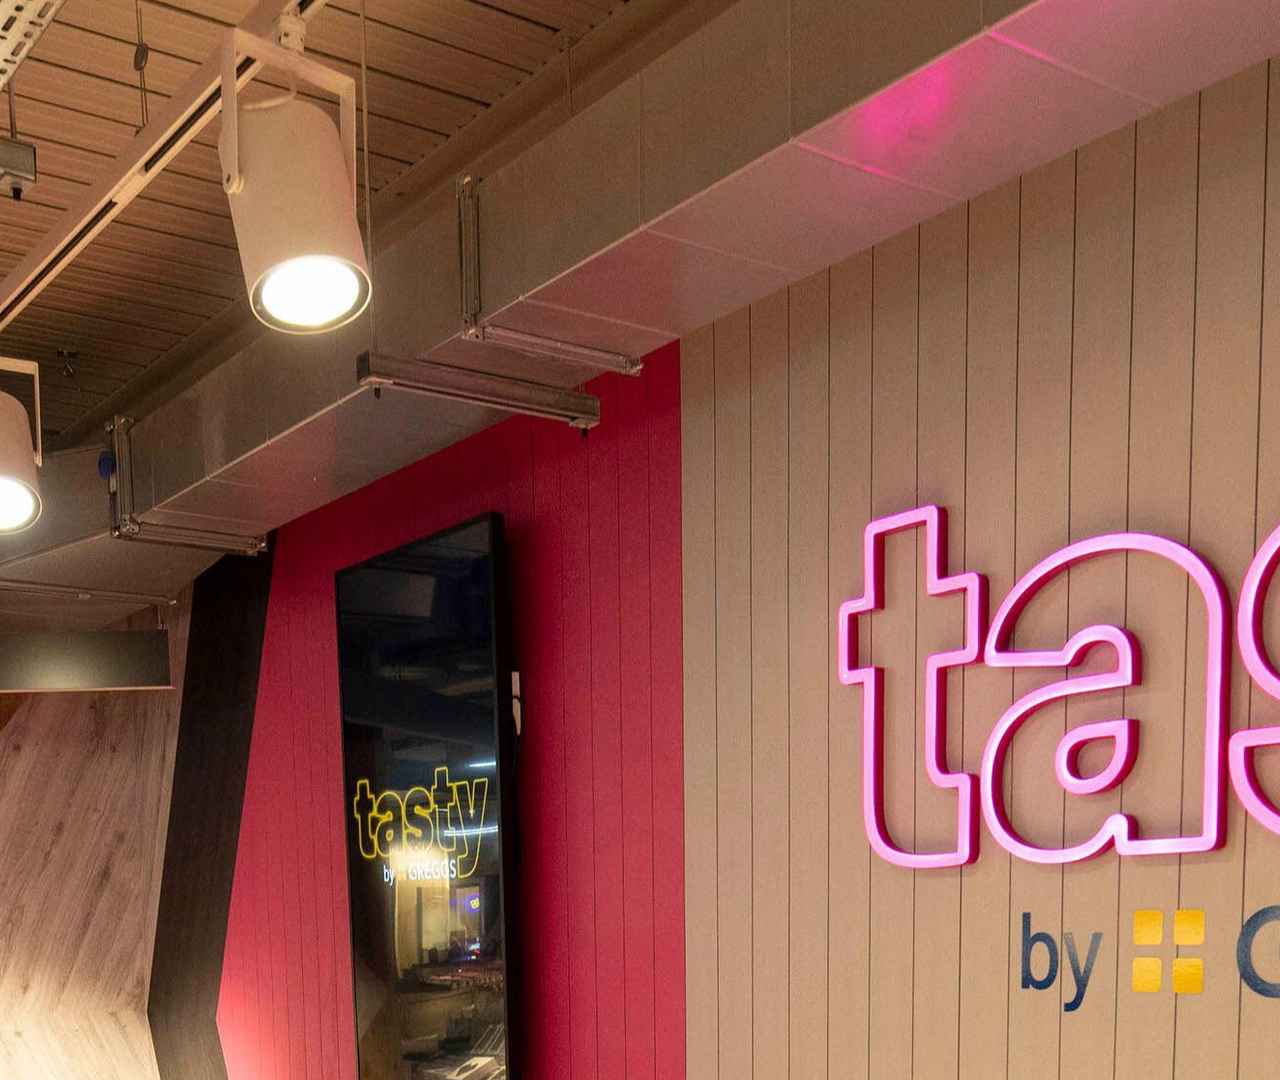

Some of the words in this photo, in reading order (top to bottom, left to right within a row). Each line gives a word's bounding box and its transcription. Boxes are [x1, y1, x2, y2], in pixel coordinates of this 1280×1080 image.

[354, 766, 489, 879] tasty
[383, 865, 395, 886] by
[408, 859, 457, 880] GREGGS
[1020, 912, 1103, 1013] by
